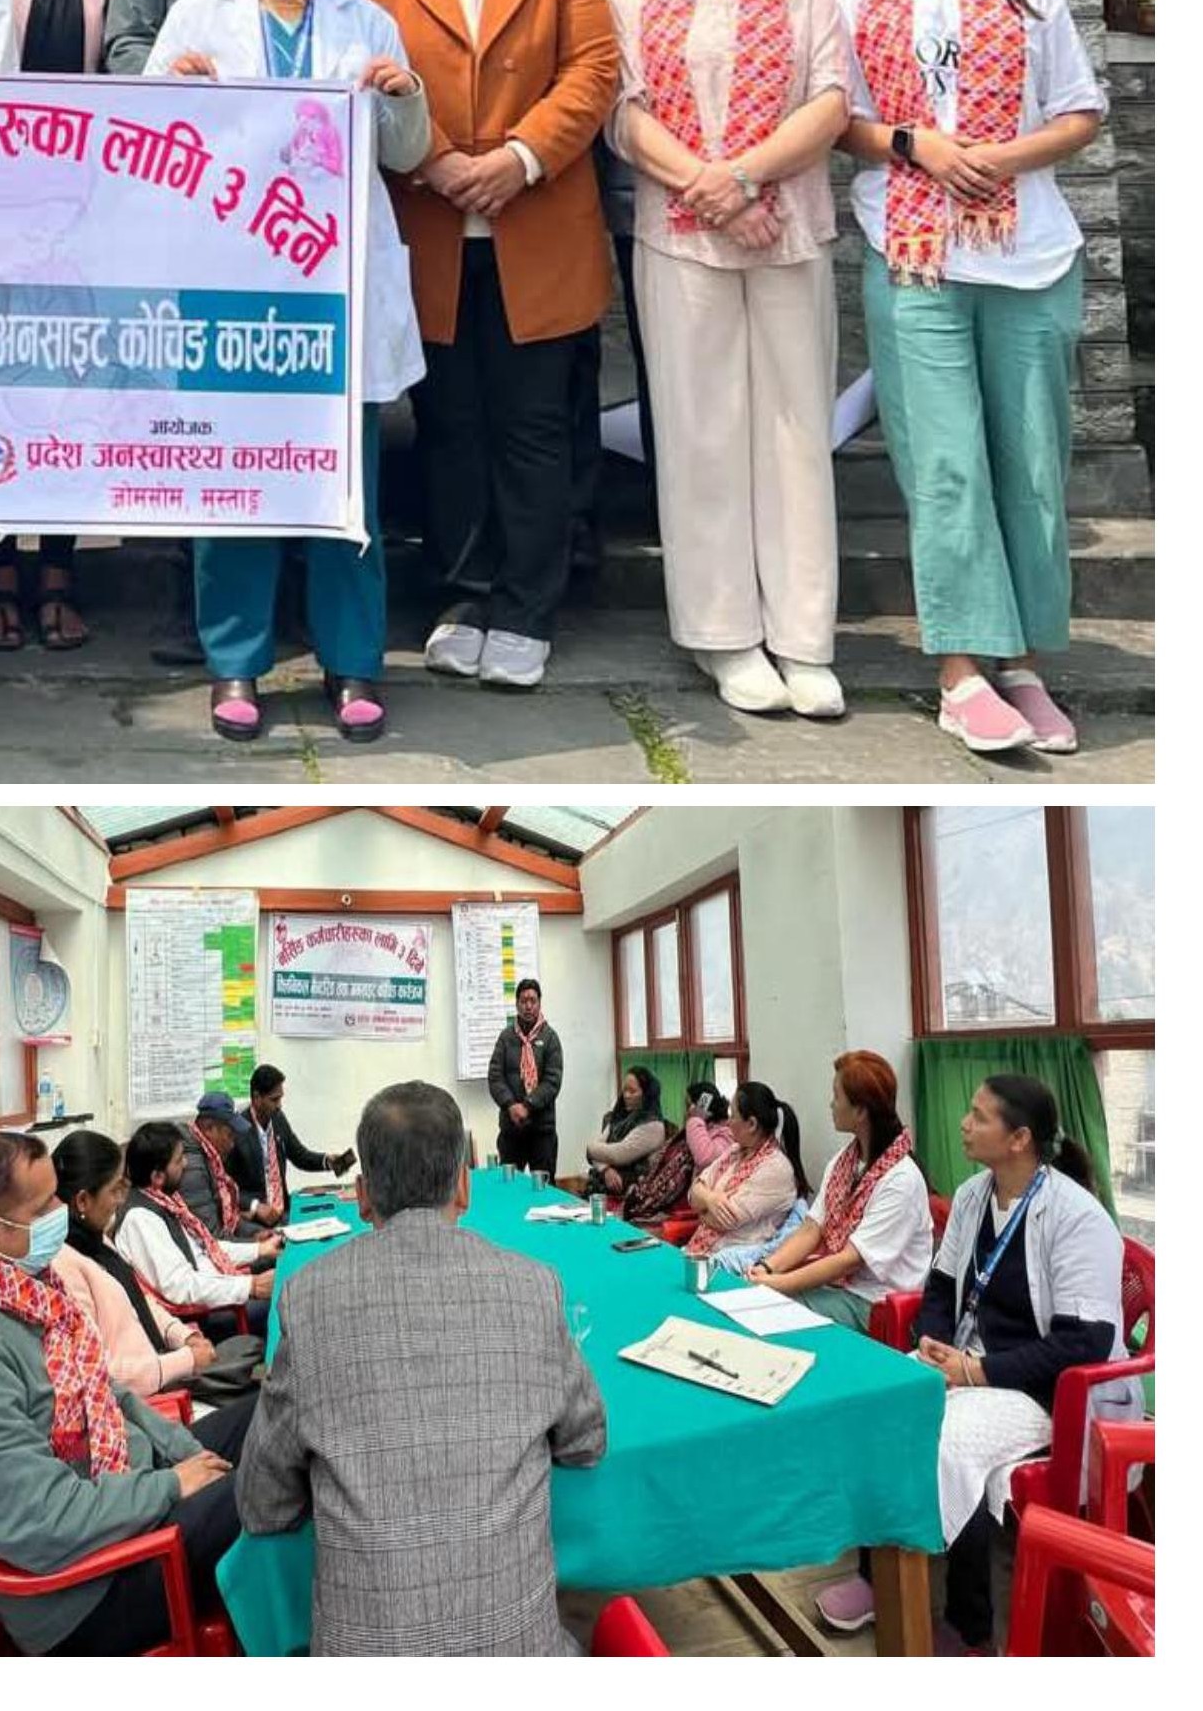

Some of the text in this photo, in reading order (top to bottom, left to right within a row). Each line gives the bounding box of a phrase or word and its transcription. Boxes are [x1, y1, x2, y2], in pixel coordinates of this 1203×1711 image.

[102, 121, 211, 199] लागि
[213, 167, 246, 221] ३
[248, 175, 339, 277] दिने
[117, 299, 209, 370] कोचिङ
[215, 306, 336, 376] कार्यक्रम
[27, 435, 338, 473] प्रदेश जनस्वास्थ्य कार्यालय
[148, 418, 213, 435] आयोजक
